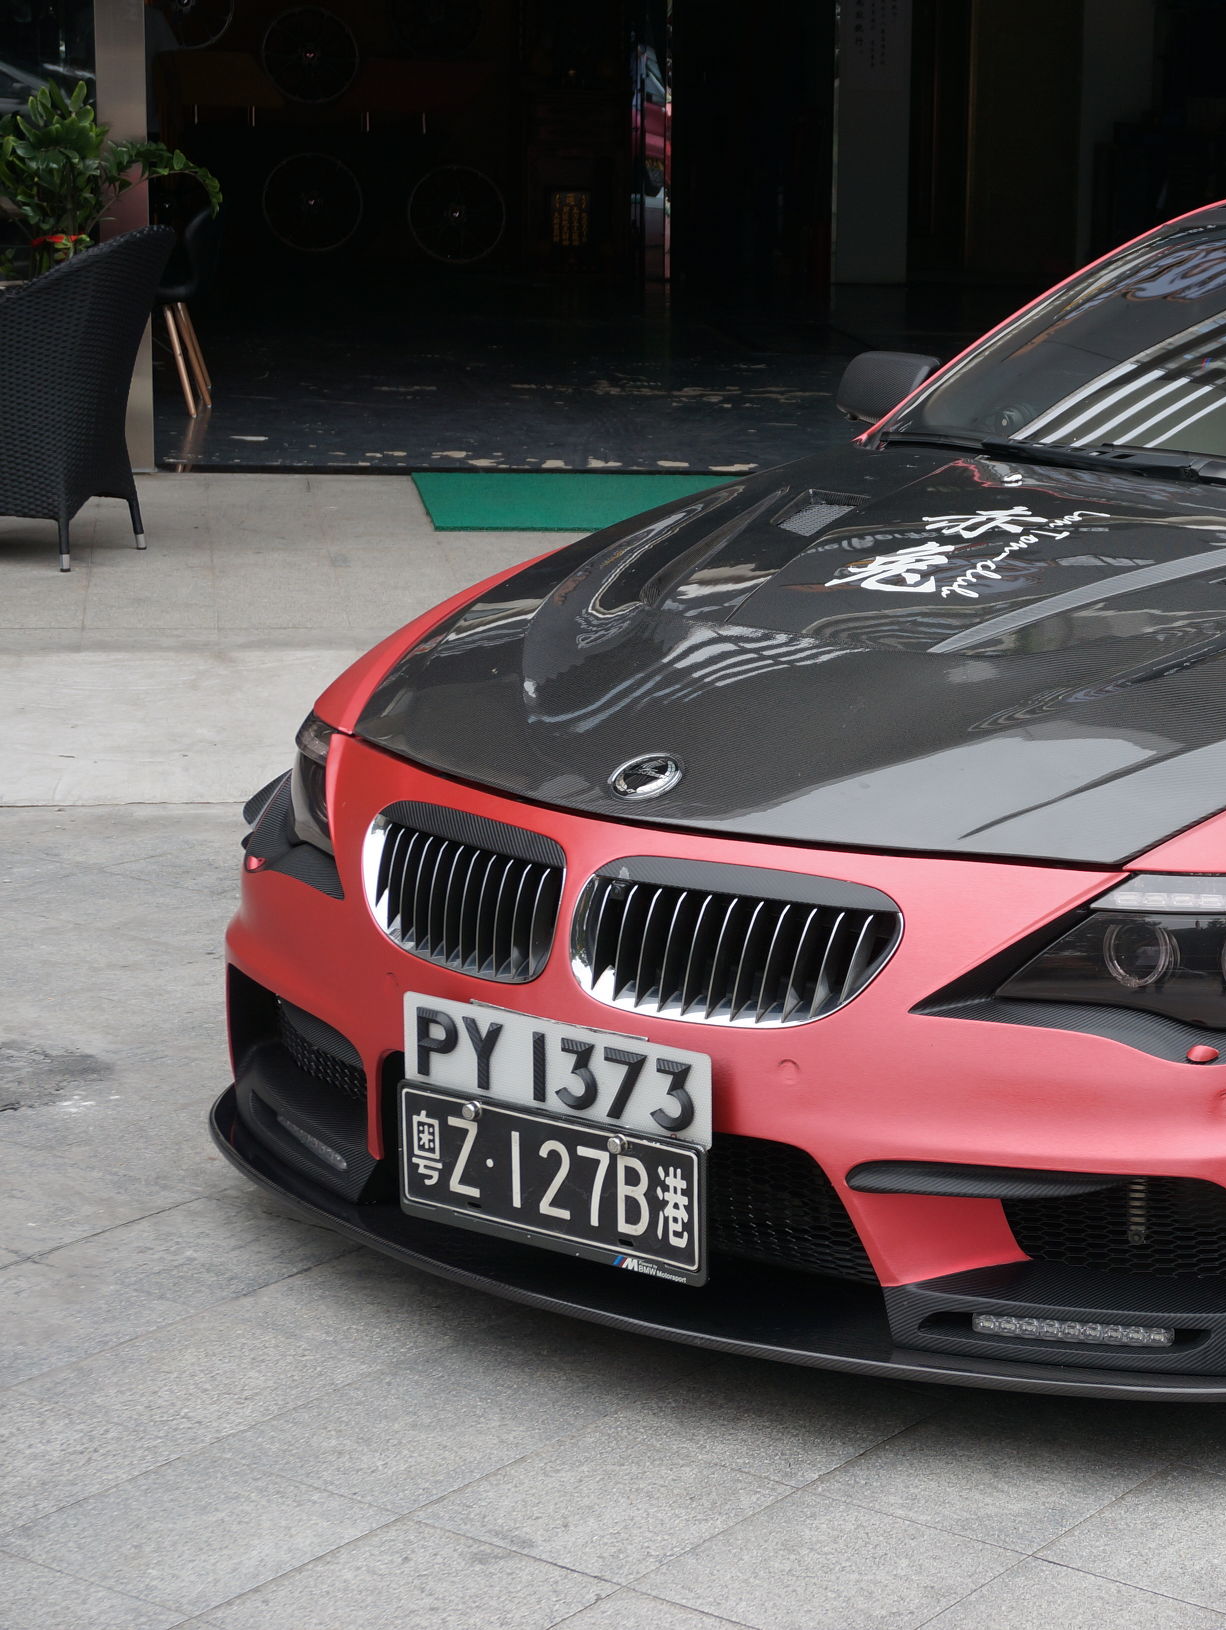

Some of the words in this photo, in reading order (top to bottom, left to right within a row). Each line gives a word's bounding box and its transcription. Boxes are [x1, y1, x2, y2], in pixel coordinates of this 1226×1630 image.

[416, 1006, 503, 1090] PY
[532, 1031, 695, 1132] 1373
[638, 1265, 657, 1276] BMW
[656, 1270, 687, 1283] Motorsport
